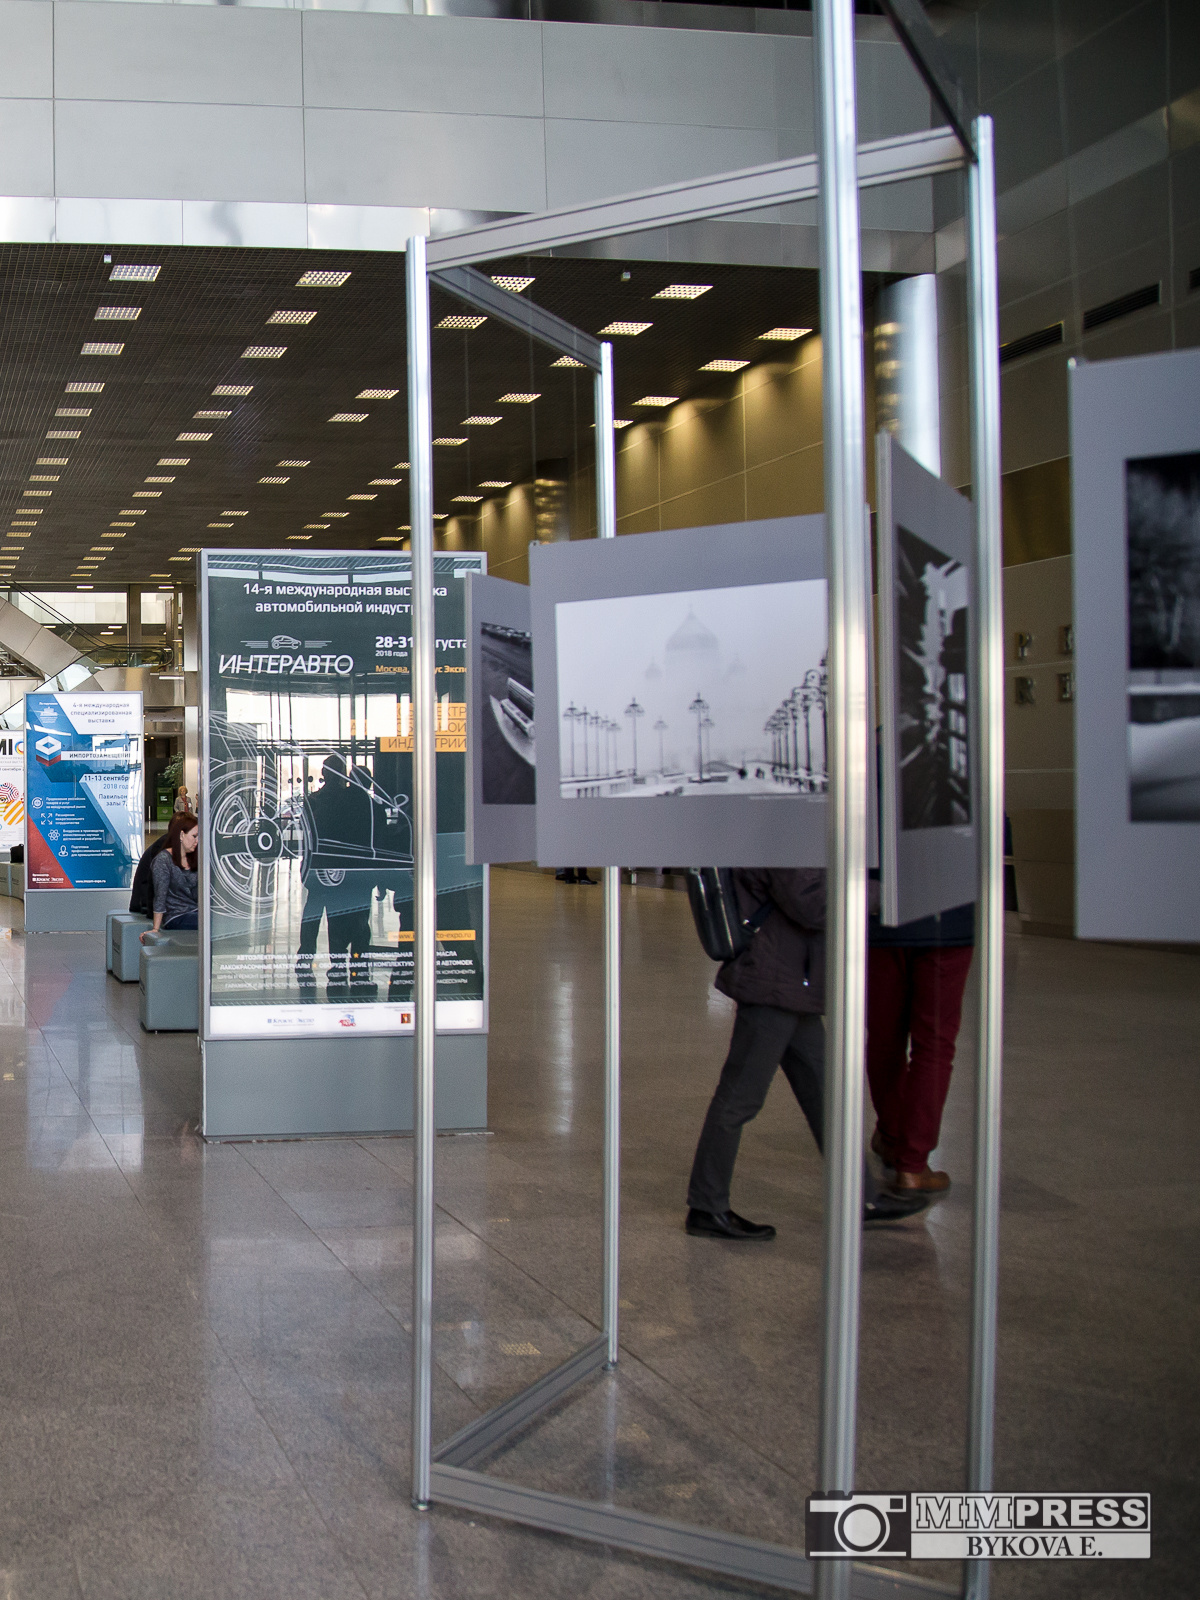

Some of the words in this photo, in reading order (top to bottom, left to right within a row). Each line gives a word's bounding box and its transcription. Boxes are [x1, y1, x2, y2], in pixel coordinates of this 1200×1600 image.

[243, 583, 273, 595] 14-я
[276, 585, 382, 598] международная
[385, 586, 448, 597] выска
[255, 601, 363, 613] автомобильной
[366, 603, 413, 616] индуст
[375, 636, 414, 649] 28-31
[218, 654, 354, 674] ИНТЕРАВТО
[375, 665, 410, 674] Москва,
[103, 774, 129, 782] сентябр
